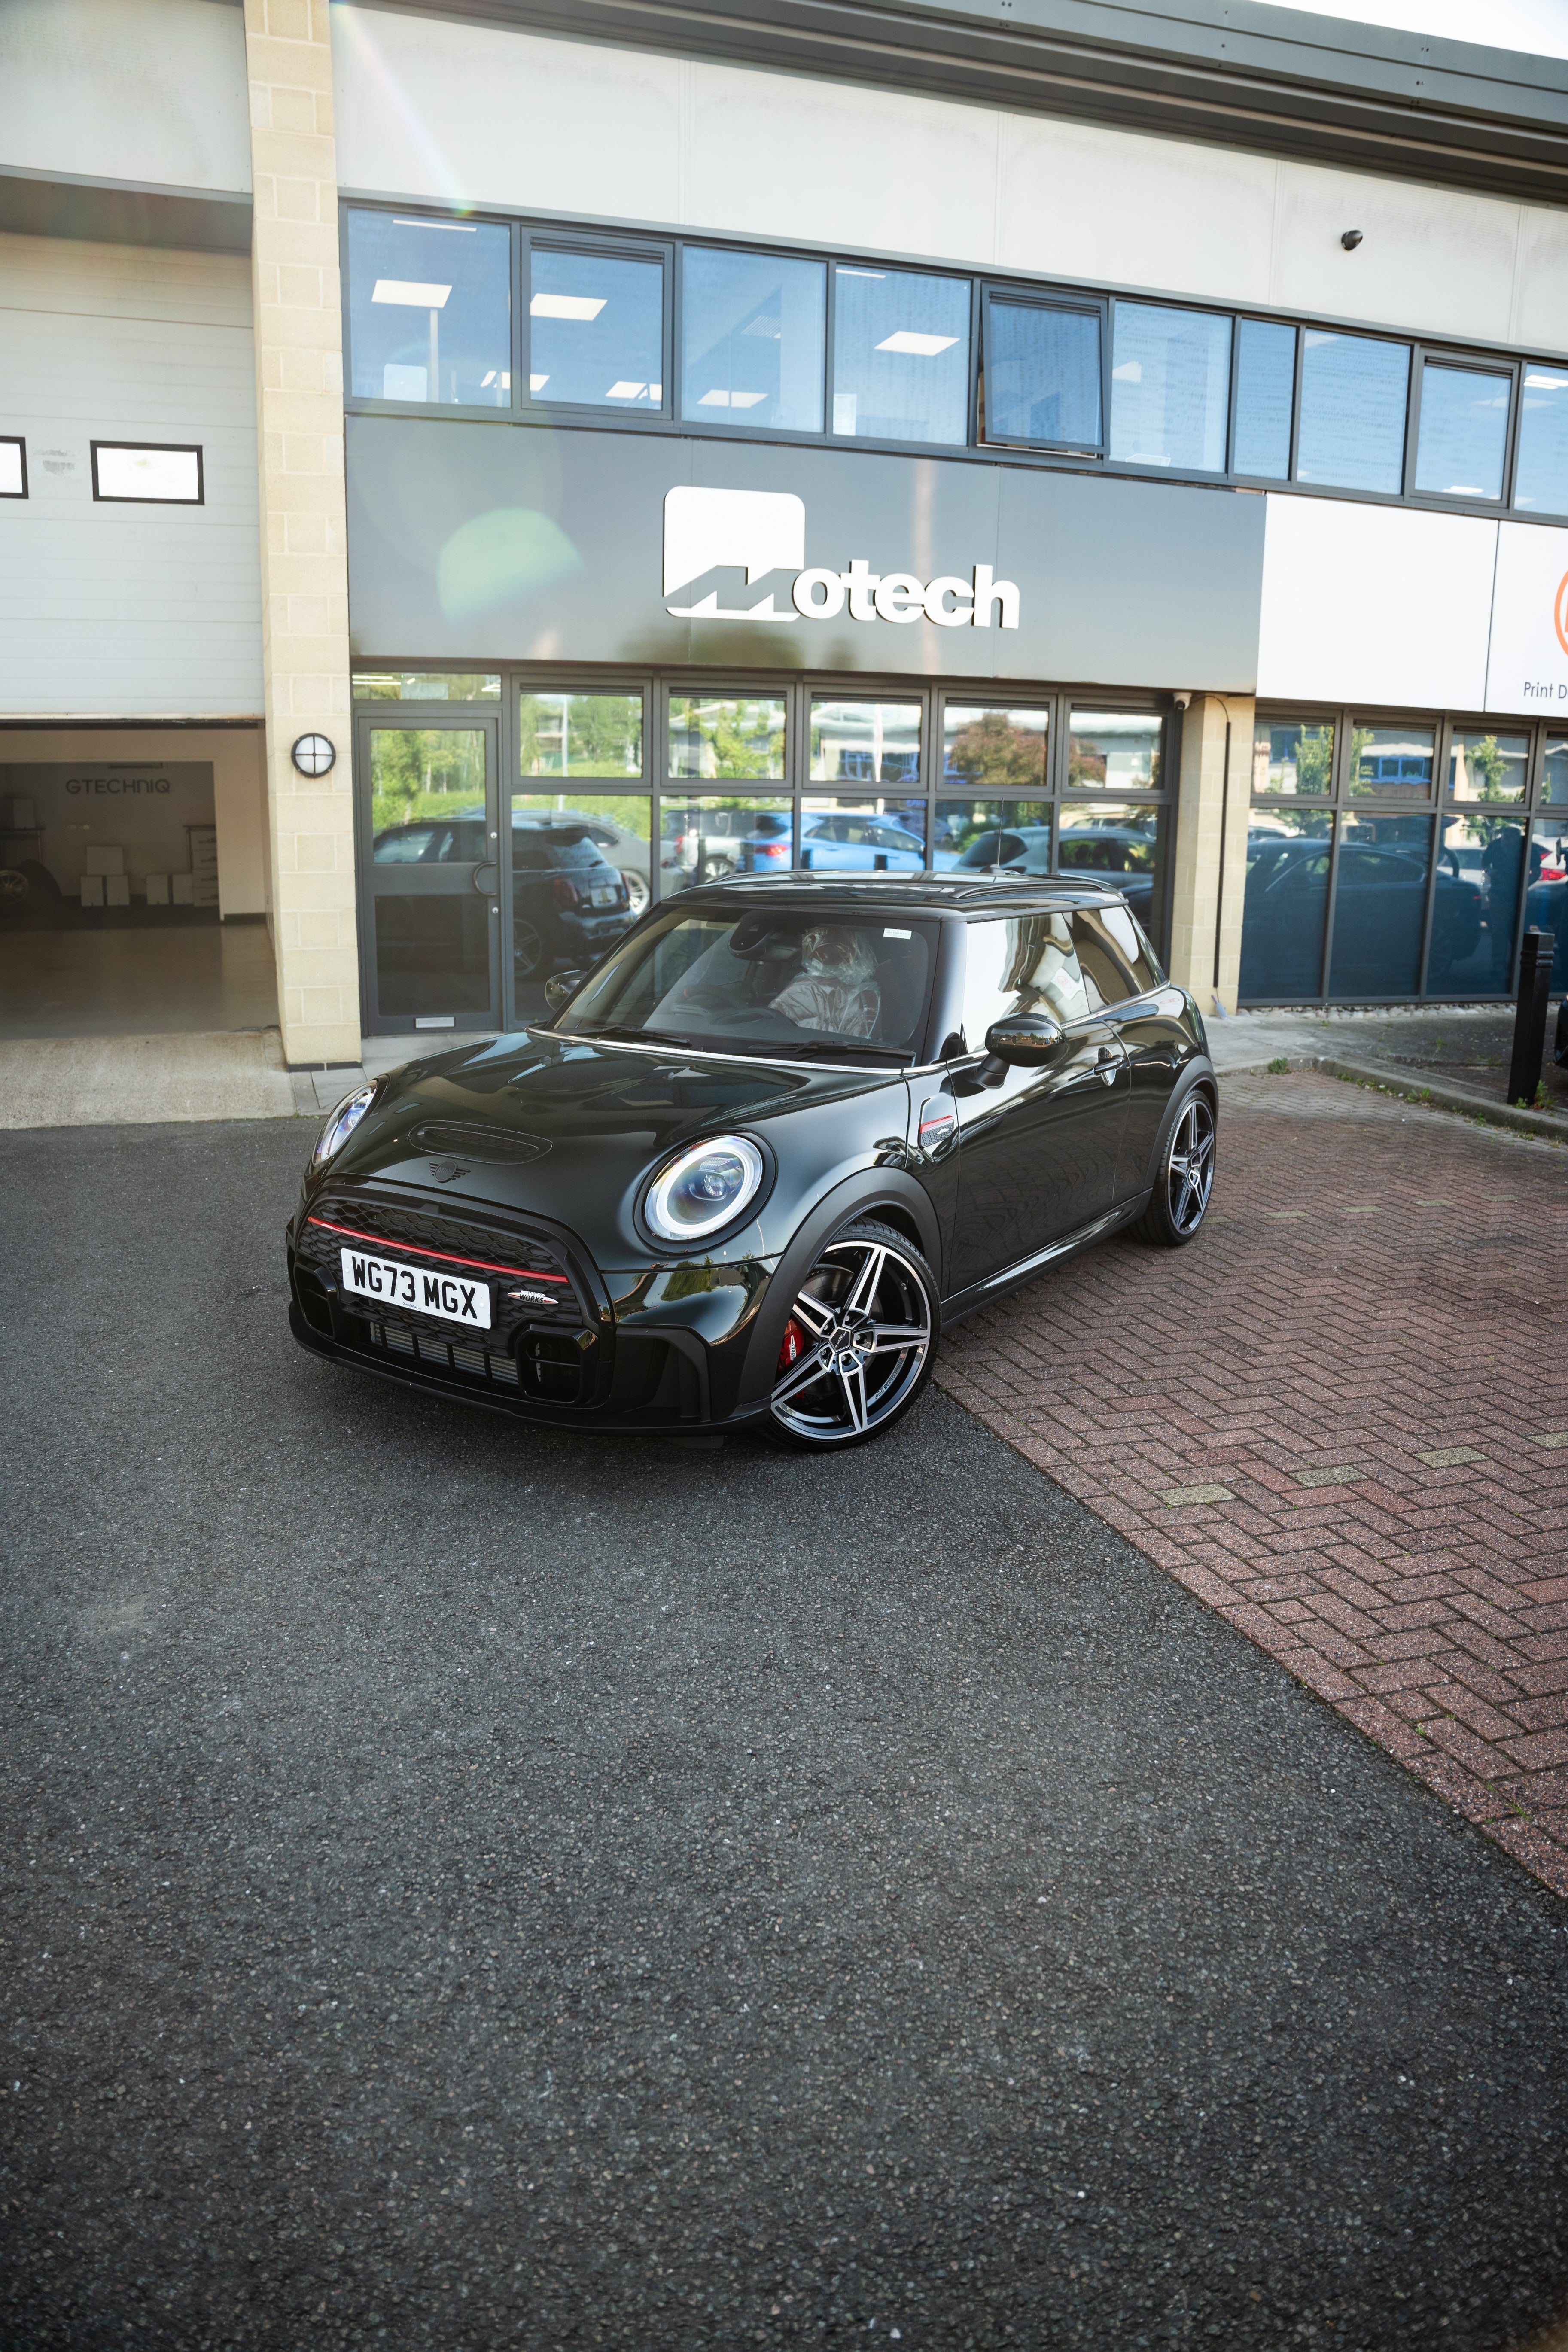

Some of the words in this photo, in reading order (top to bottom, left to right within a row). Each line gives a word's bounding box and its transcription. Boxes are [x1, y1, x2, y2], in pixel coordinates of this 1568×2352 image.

[663, 485, 1020, 629] Motech
[1524, 682, 1553, 698] Print
[1558, 684, 1568, 699] D
[66, 779, 170, 794] GTECHNIQ
[352, 1256, 416, 1302] WG73
[423, 1275, 478, 1320] MGX
[520, 1294, 544, 1303] WORKS
